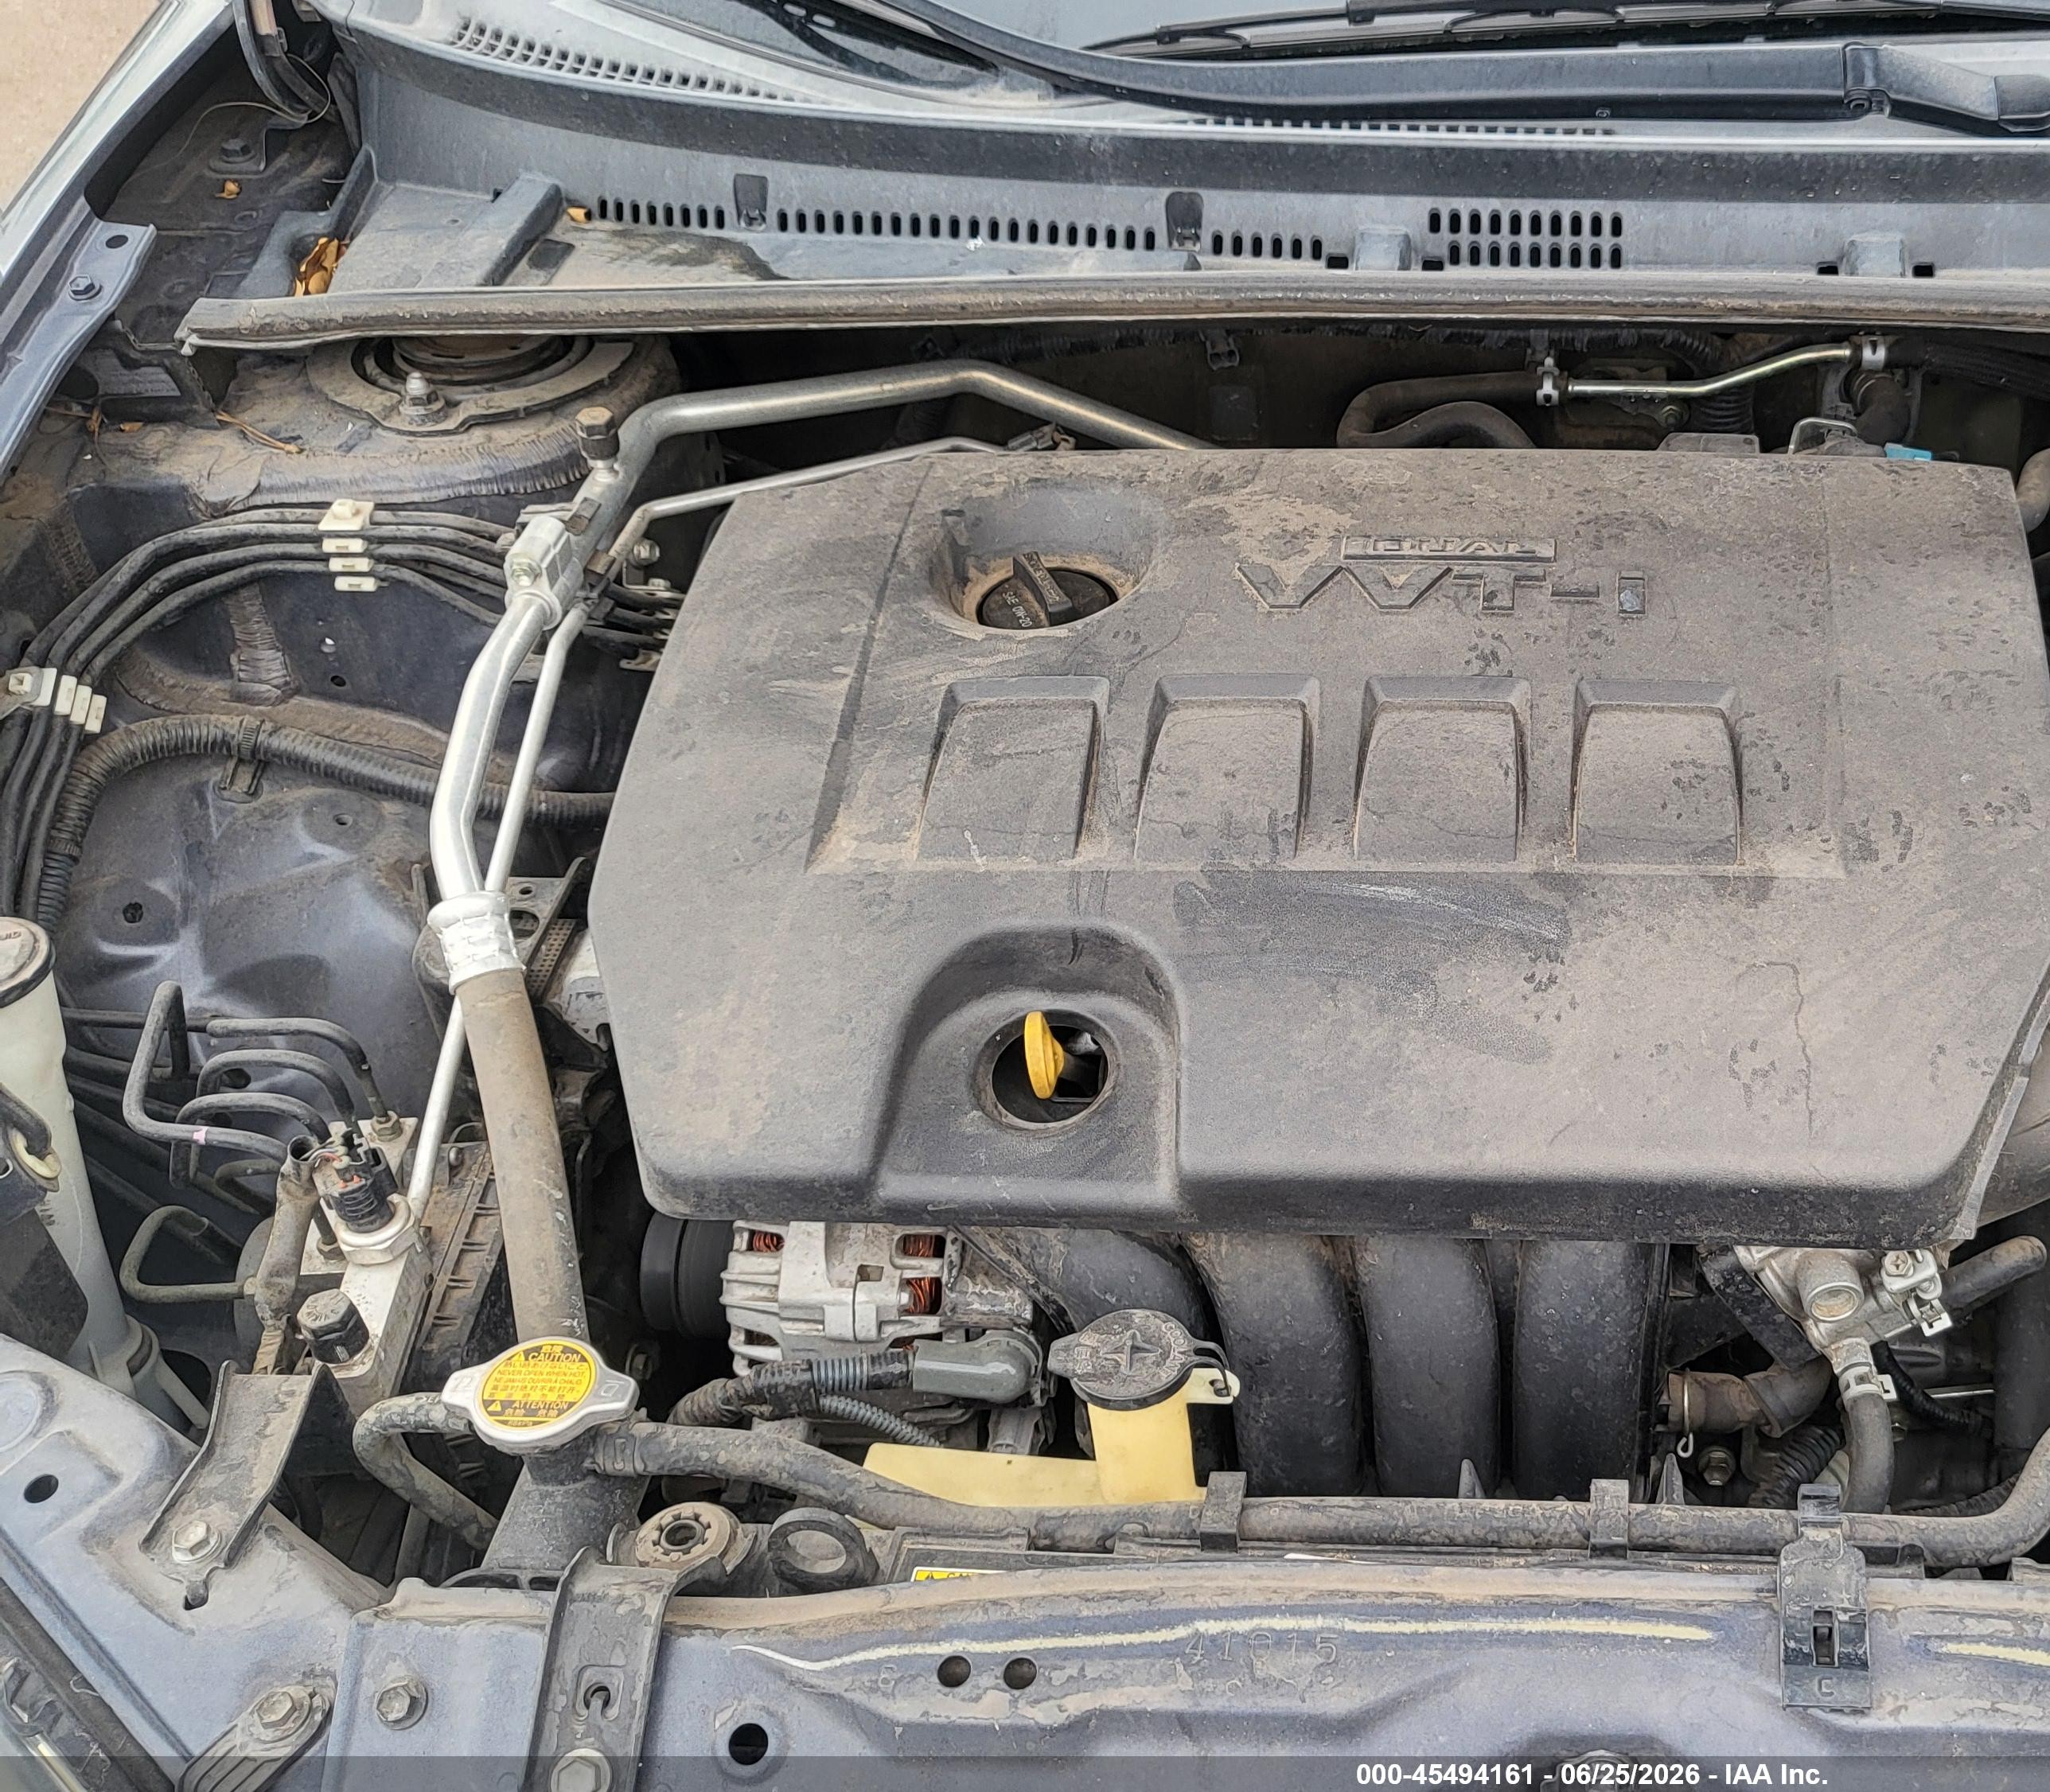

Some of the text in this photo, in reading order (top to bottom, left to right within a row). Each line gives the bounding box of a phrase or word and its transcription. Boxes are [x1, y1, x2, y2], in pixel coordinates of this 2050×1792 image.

[1003, 590, 1033, 628] SAE 0W-20
[528, 1353, 581, 1362] CAUTION
[512, 1400, 569, 1409] ATTENTION
